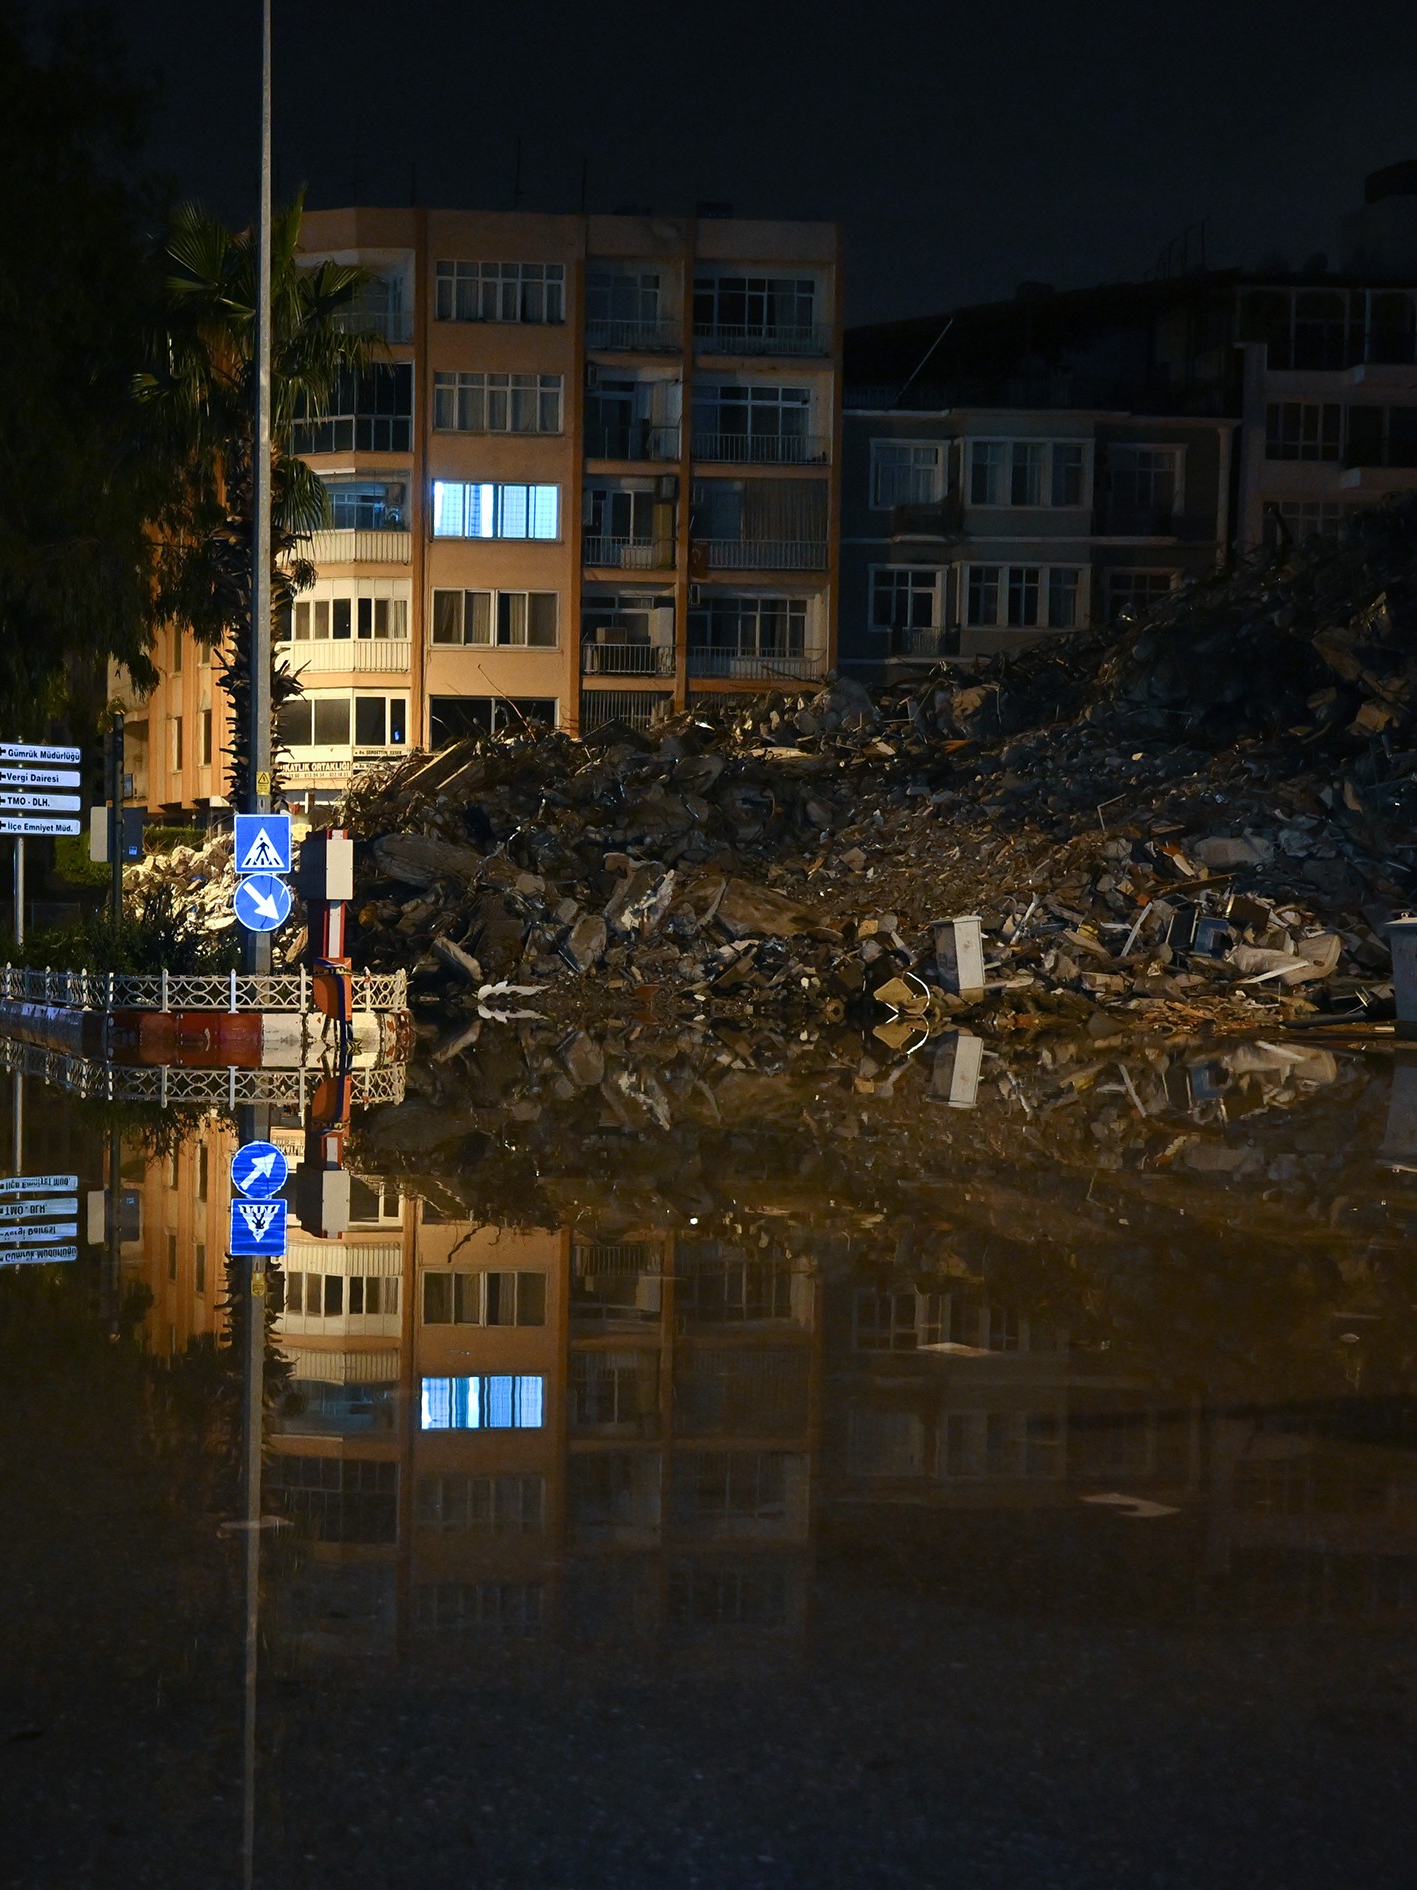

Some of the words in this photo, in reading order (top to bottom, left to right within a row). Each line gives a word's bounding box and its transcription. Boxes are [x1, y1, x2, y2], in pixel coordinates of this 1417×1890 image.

[8, 749, 38, 758] Gümrük
[40, 750, 80, 762] Müdürlüğü
[277, 763, 310, 772] UKATLIK
[311, 761, 350, 772] ORTAKLIĞI
[6, 772, 28, 783] Vergi
[30, 773, 59, 783] Dairesi
[7, 797, 26, 805] TMO
[33, 798, 51, 807] DLH.
[7, 821, 22, 831] İlçe
[24, 823, 54, 833] Emniyet
[55, 824, 73, 832] Müd.
